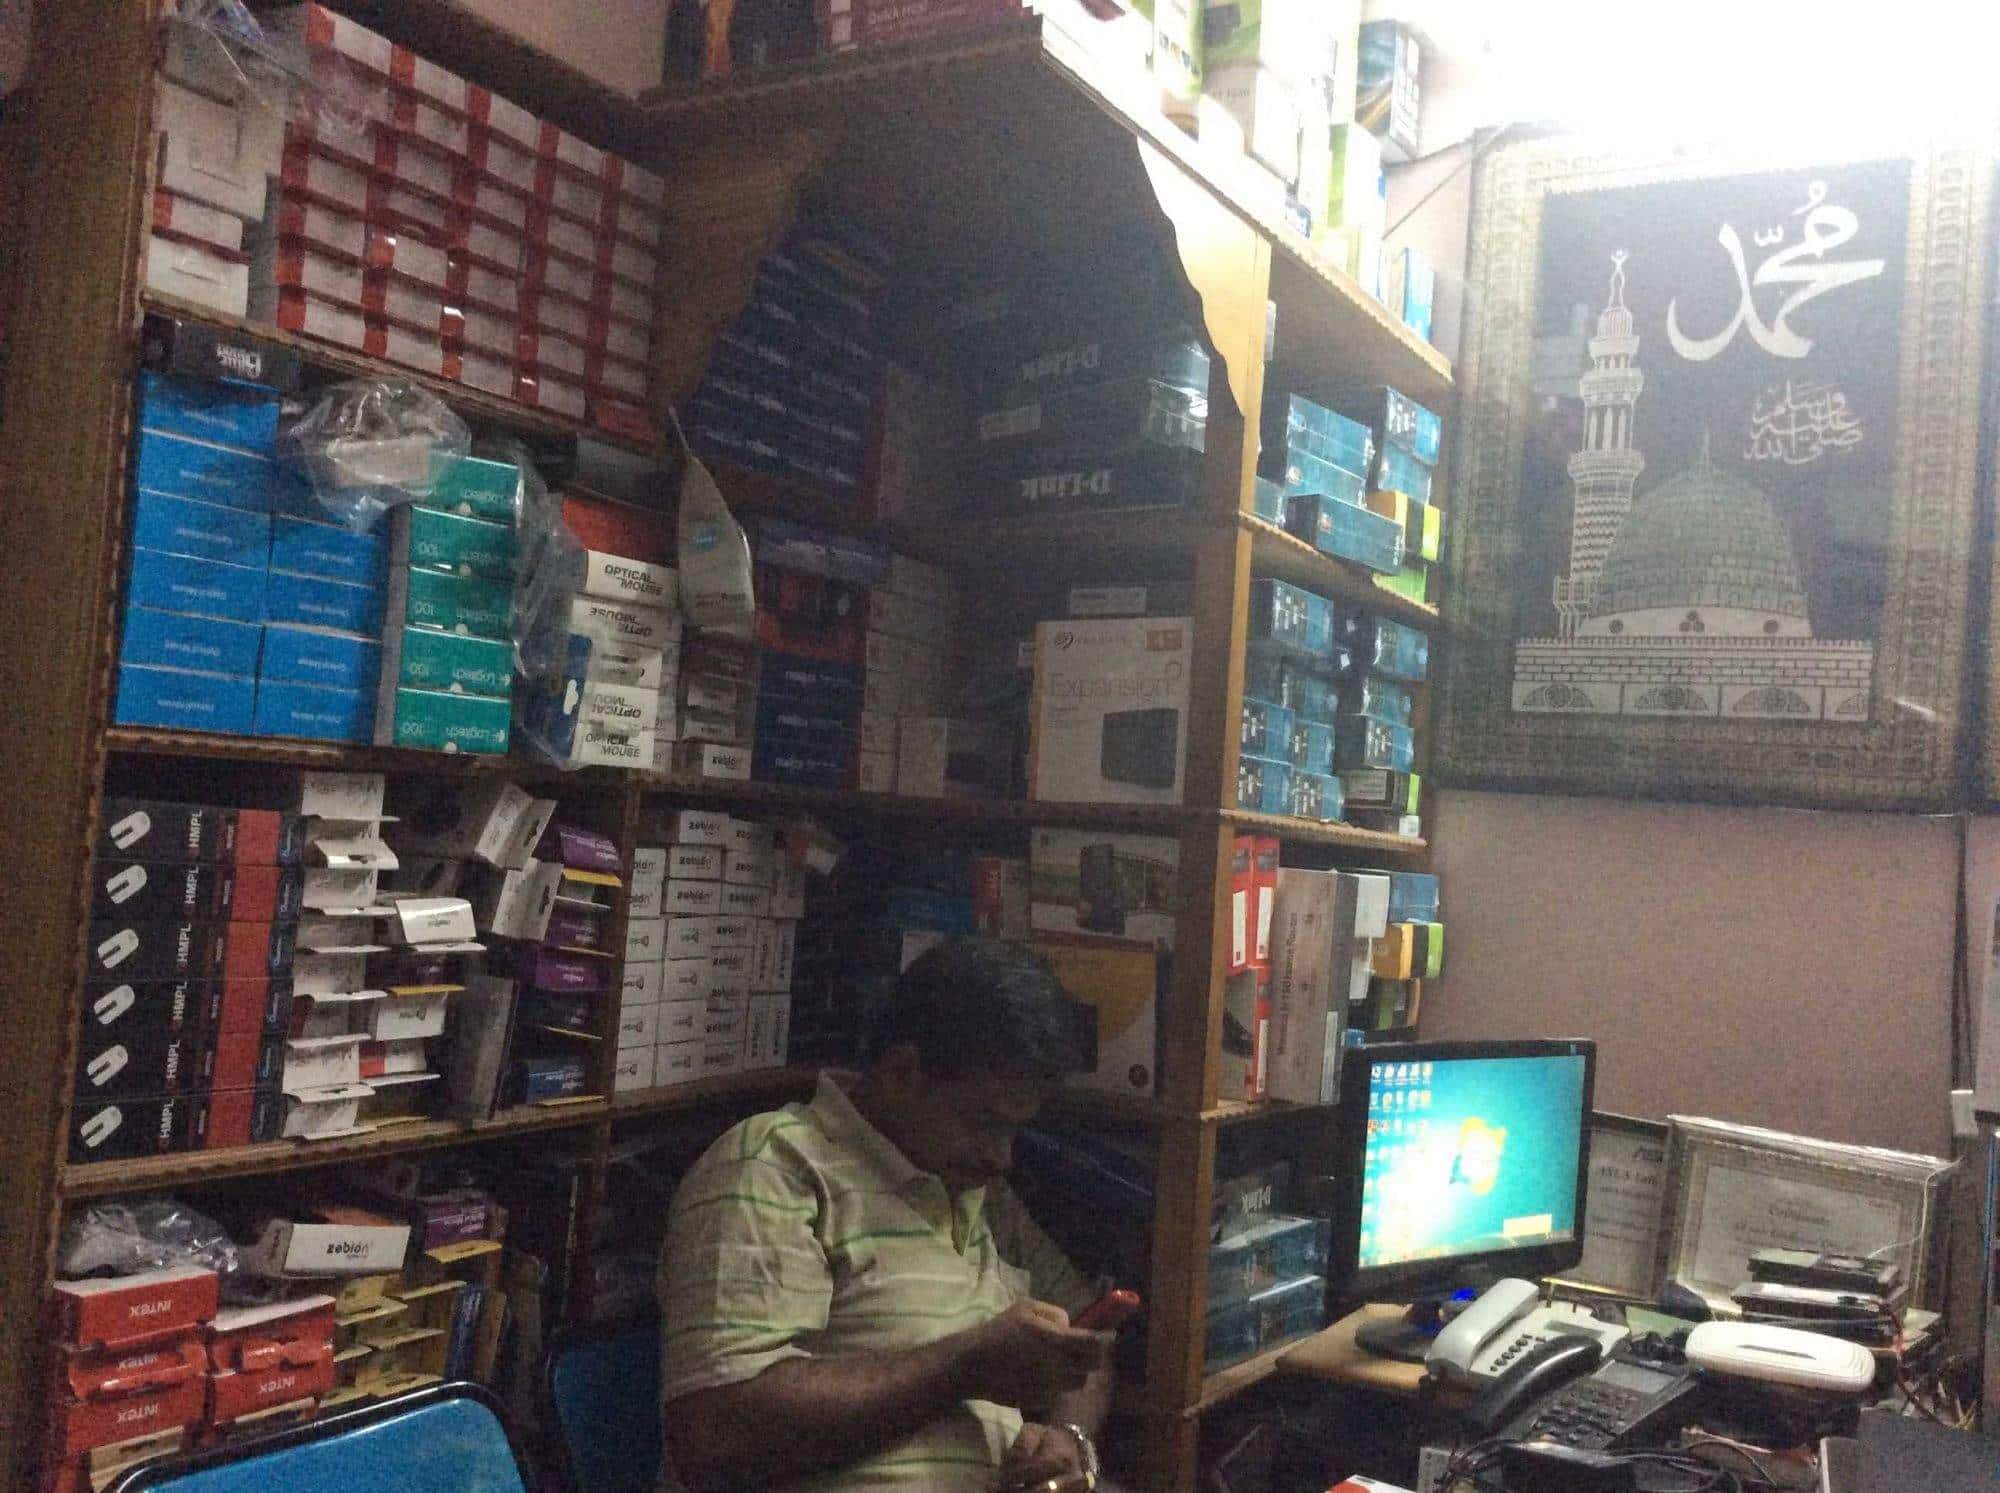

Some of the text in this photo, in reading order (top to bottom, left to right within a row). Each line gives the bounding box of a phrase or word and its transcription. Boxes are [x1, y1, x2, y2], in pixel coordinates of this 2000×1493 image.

[1021, 470, 1112, 500] D-Link
[605, 564, 654, 584] OPTICAL
[619, 577, 663, 596] MOUSE
[452, 666, 496, 684] Logitech
[445, 725, 490, 741] Logitech
[602, 745, 641, 758] MOUSE
[189, 809, 203, 848] HMPL
[185, 865, 199, 904] HMPL
[177, 923, 191, 962] HMPL
[173, 981, 187, 1020] HMPL
[166, 1039, 180, 1079] HMPL
[160, 1098, 174, 1138] HMPL
